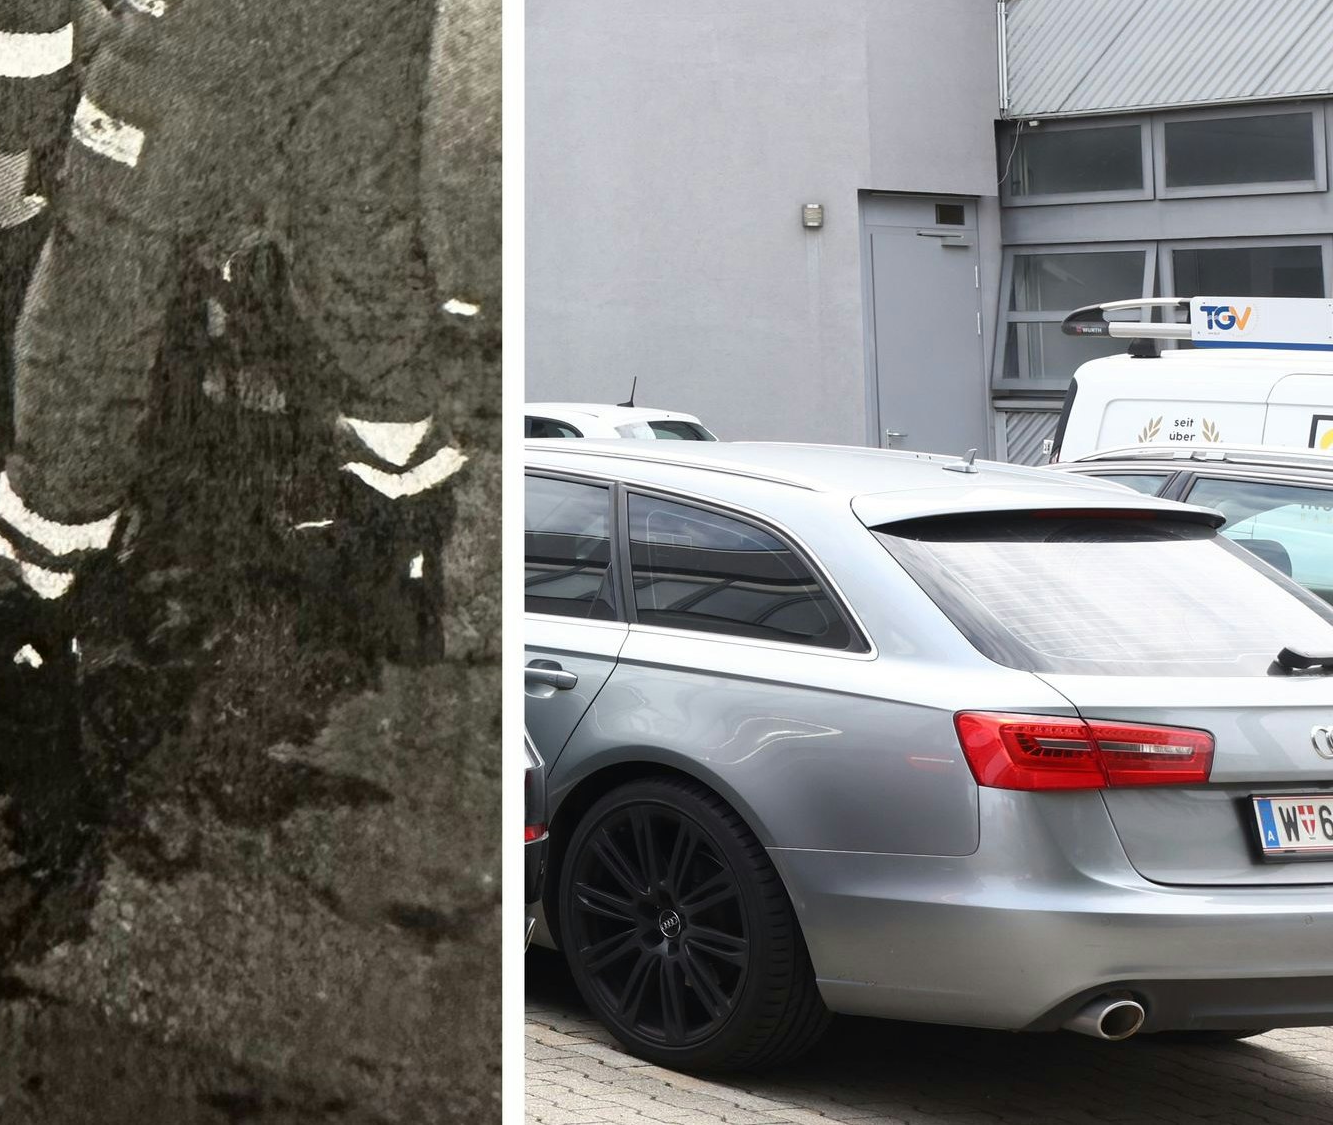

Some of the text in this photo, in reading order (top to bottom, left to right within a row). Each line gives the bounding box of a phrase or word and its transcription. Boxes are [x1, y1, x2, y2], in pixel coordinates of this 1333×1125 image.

[1200, 306, 1252, 330] TGV
[1174, 417, 1194, 427] seit
[1268, 805, 1333, 842] A W 6
